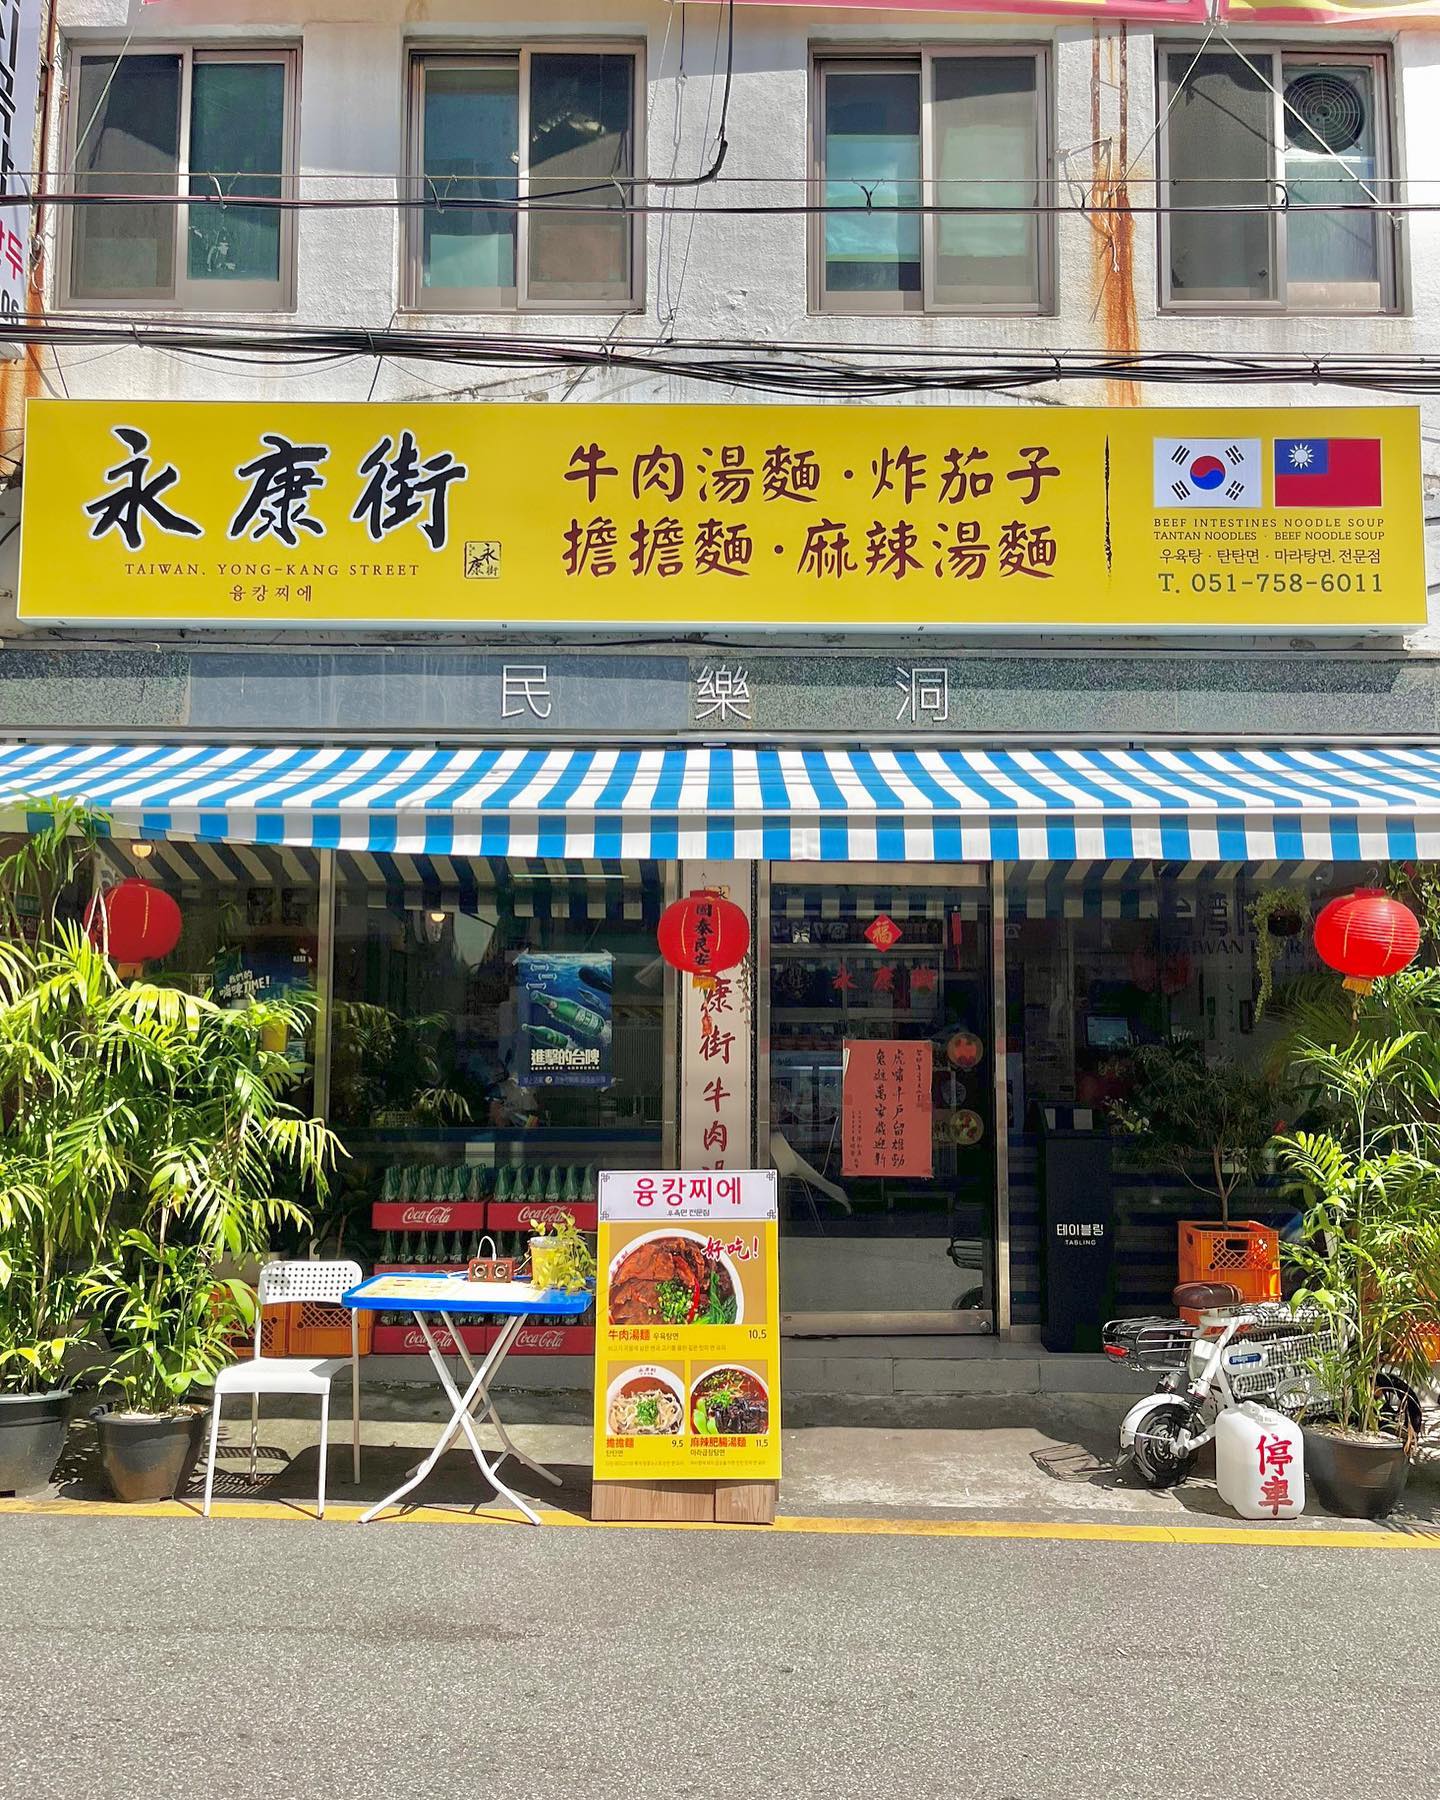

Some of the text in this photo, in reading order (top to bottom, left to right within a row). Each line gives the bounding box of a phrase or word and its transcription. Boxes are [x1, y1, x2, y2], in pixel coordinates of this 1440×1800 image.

[86, 427, 467, 550] 永康街
[1154, 518, 1384, 528] BEEF INTESTINES NOODLE SOUP
[1154, 531, 1385, 541] TANTAN NOODLES BEEF NOODLE SOUP
[1160, 549, 1202, 564] 우육탕
[1217, 549, 1259, 564] 탄탄면
[1339, 549, 1381, 564] 전문점
[218, 562, 339, 577] YONG-KANG
[349, 563, 420, 577] STREET
[1158, 573, 1384, 594] T. 051-758-6011
[229, 584, 313, 602] 융캉찌에
[501, 664, 949, 722] 民樂洞
[633, 1177, 741, 1207] 융캉찌에
[1056, 1223, 1104, 1237] 테이블링
[748, 1329, 767, 1339] 10.5
[671, 1439, 684, 1449] 9.5
[755, 1439, 769, 1448] 11.5
[1256, 1433, 1295, 1517] 停車
